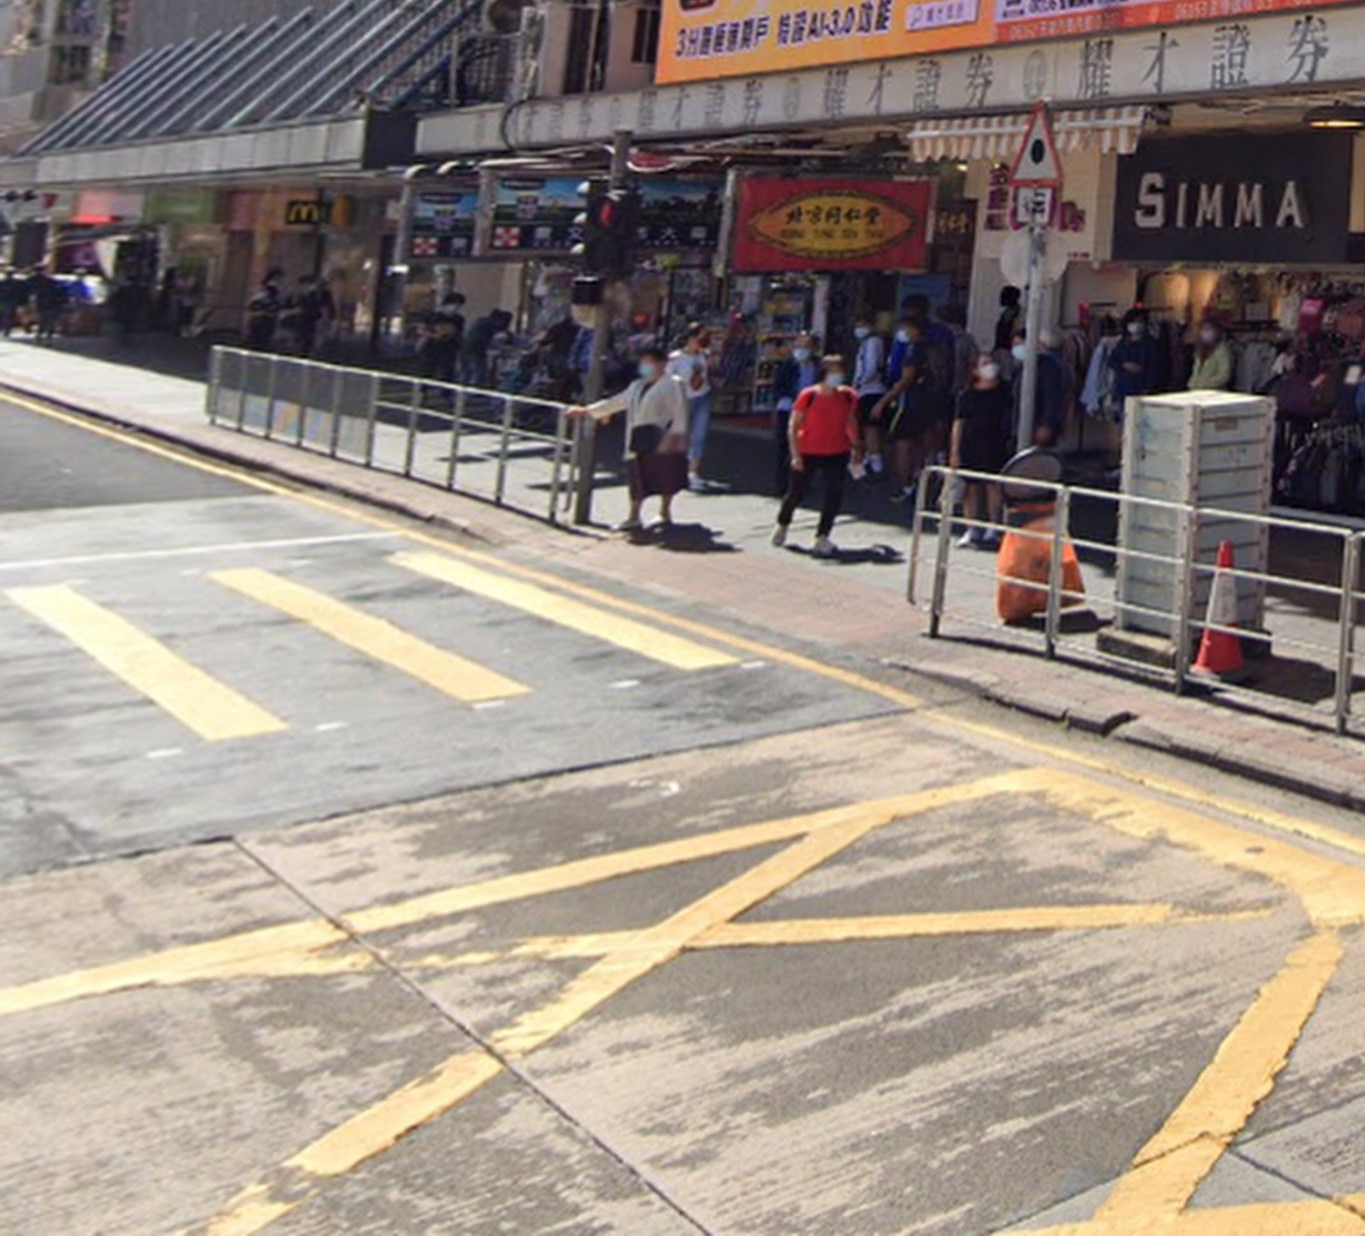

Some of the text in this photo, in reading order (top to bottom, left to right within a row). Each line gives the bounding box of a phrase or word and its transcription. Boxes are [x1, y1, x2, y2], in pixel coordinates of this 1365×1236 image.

[1078, 13, 1330, 99] 耀才證券
[1134, 171, 1305, 230] SIMMA
